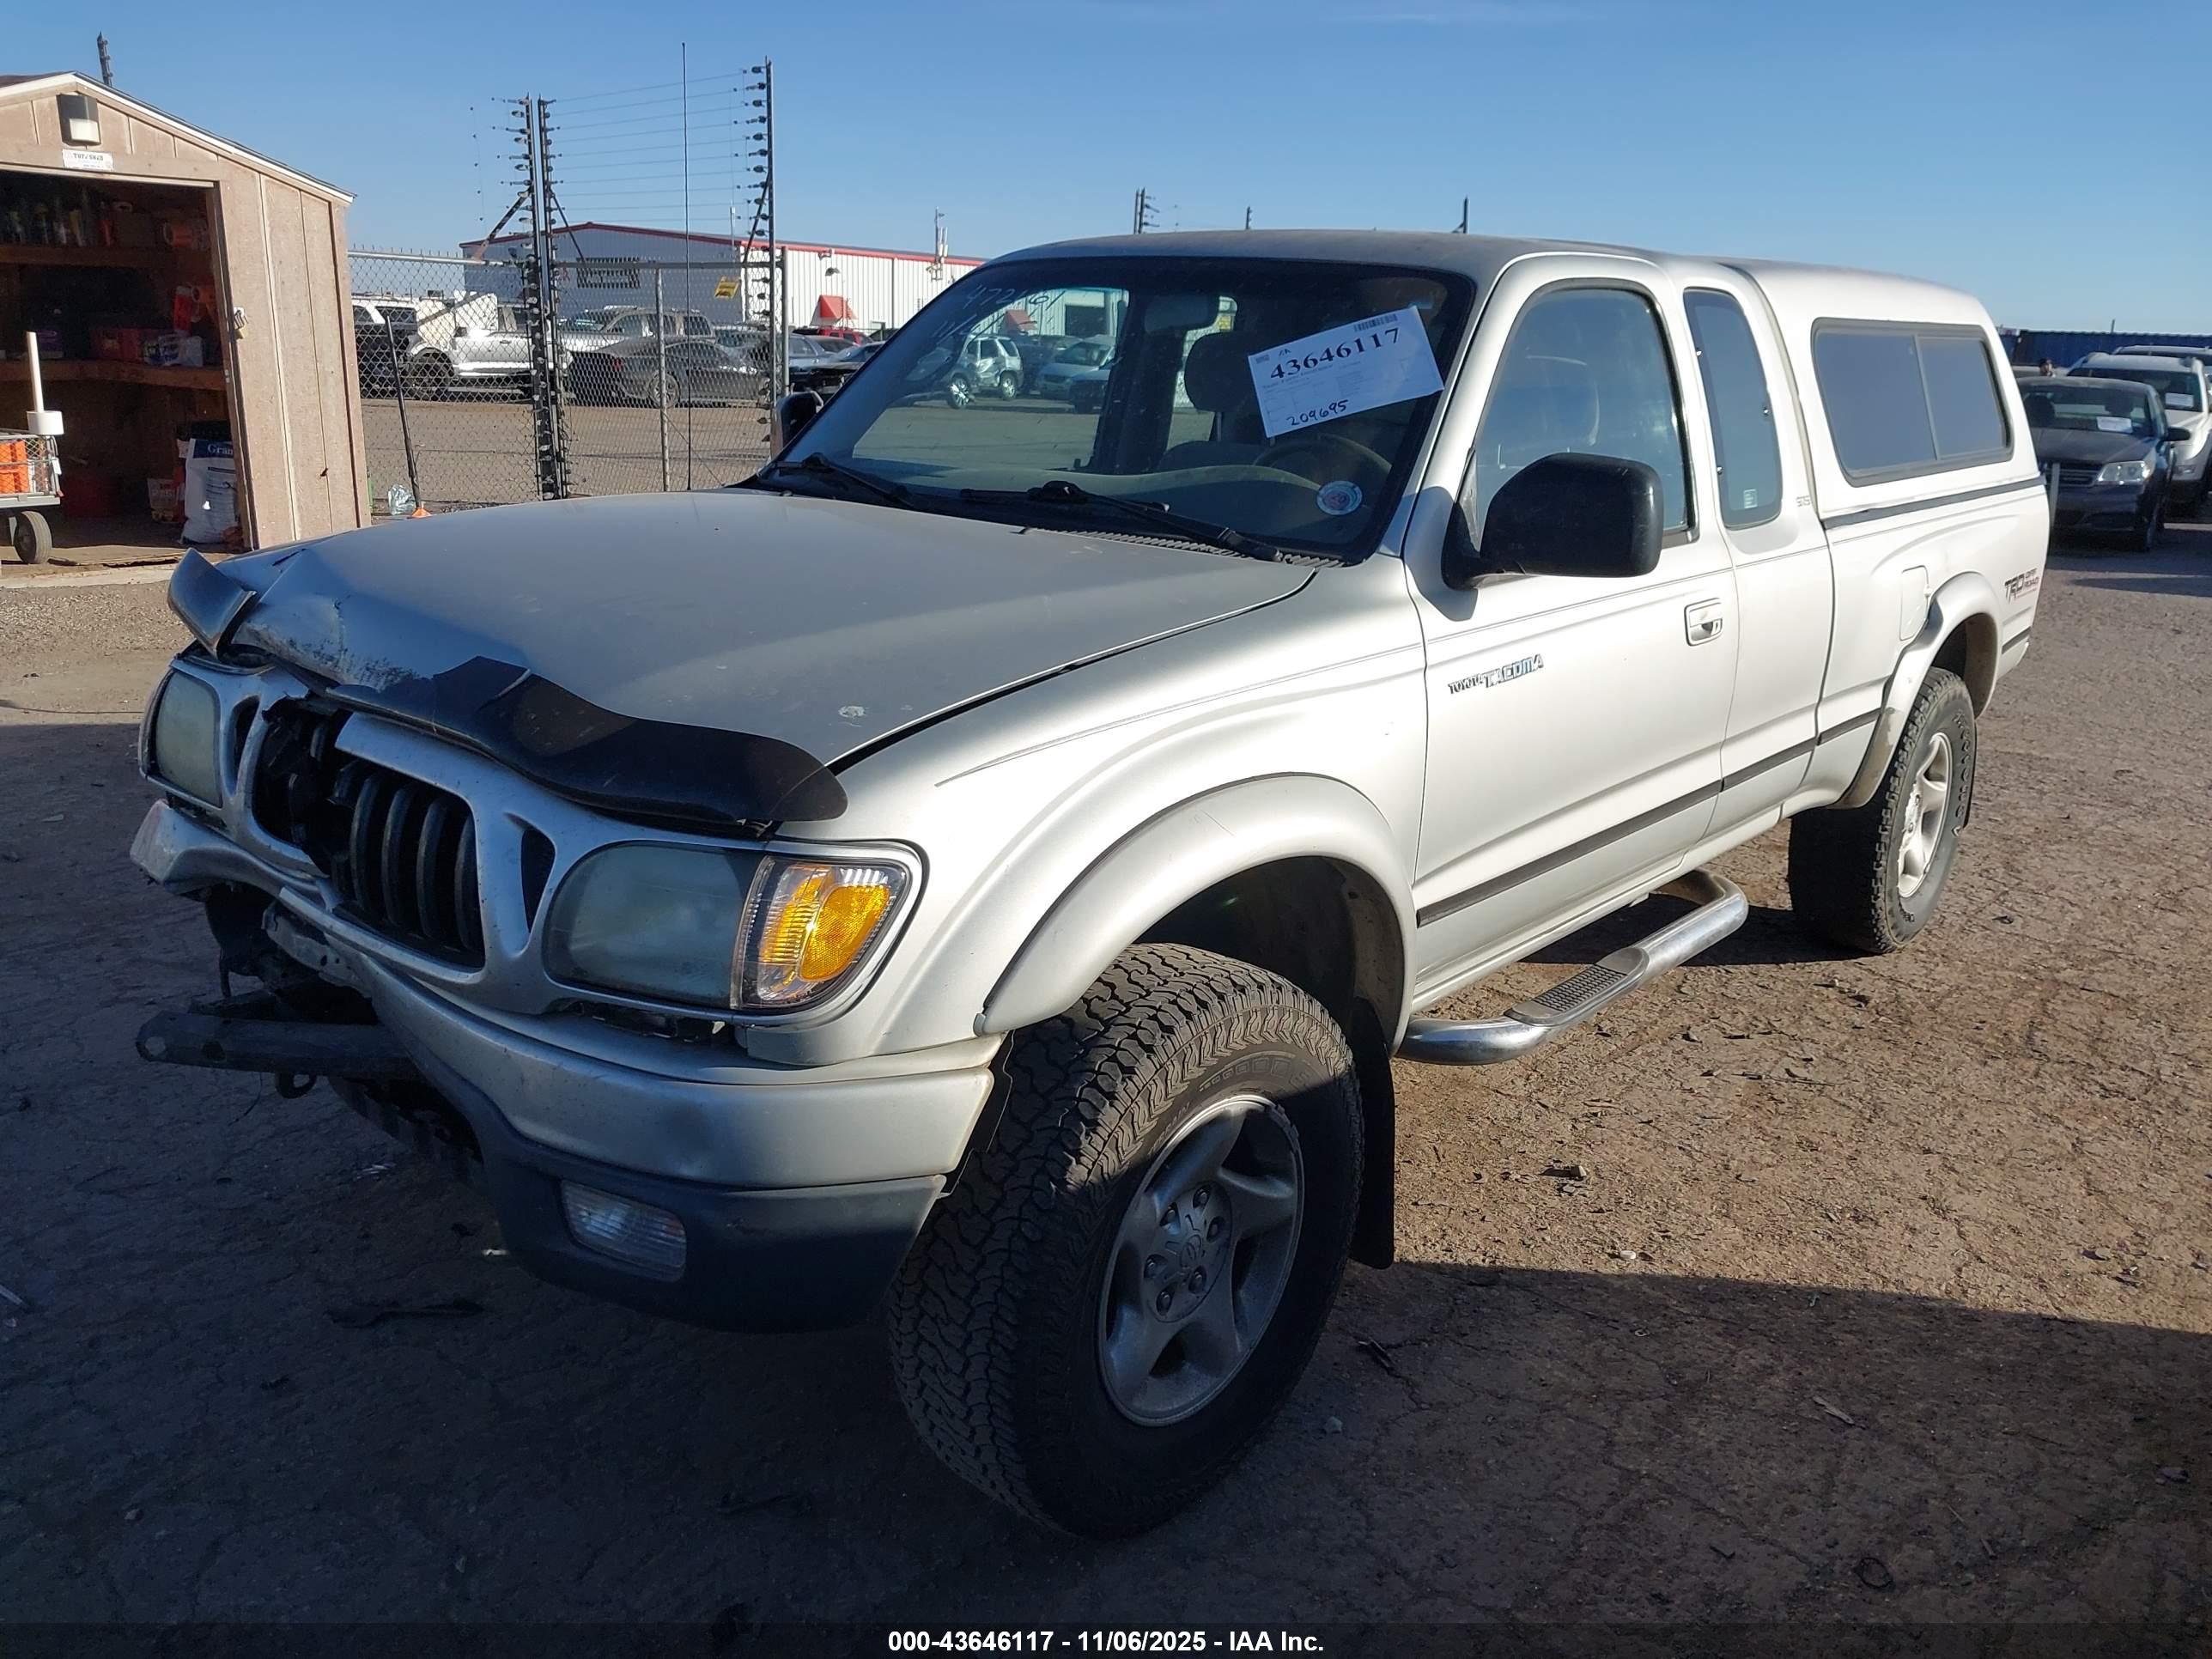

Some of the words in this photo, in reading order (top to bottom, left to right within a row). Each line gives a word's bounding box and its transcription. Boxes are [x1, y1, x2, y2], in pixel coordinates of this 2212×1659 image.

[1270, 327, 1400, 379] 43646117
[1286, 399, 1349, 426] 209695
[2004, 573, 2025, 604] TRD
[1482, 653, 1544, 689] TACOMA
